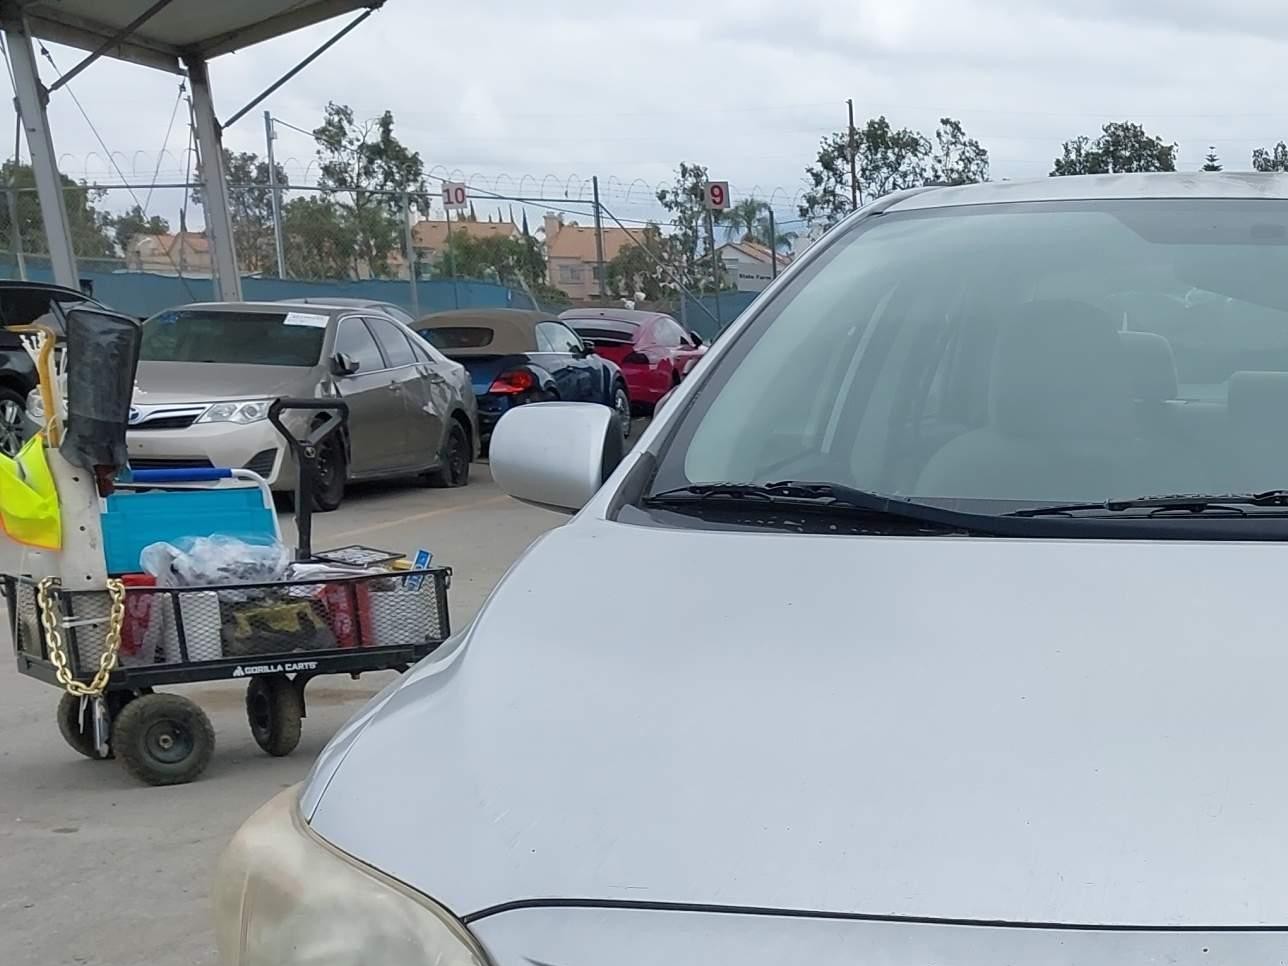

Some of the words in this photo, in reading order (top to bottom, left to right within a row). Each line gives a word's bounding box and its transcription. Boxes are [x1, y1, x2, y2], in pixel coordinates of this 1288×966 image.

[443, 187, 465, 205] 10
[710, 185, 724, 205] 9
[244, 664, 284, 675] GORILLA
[285, 661, 318, 671] CARTS
